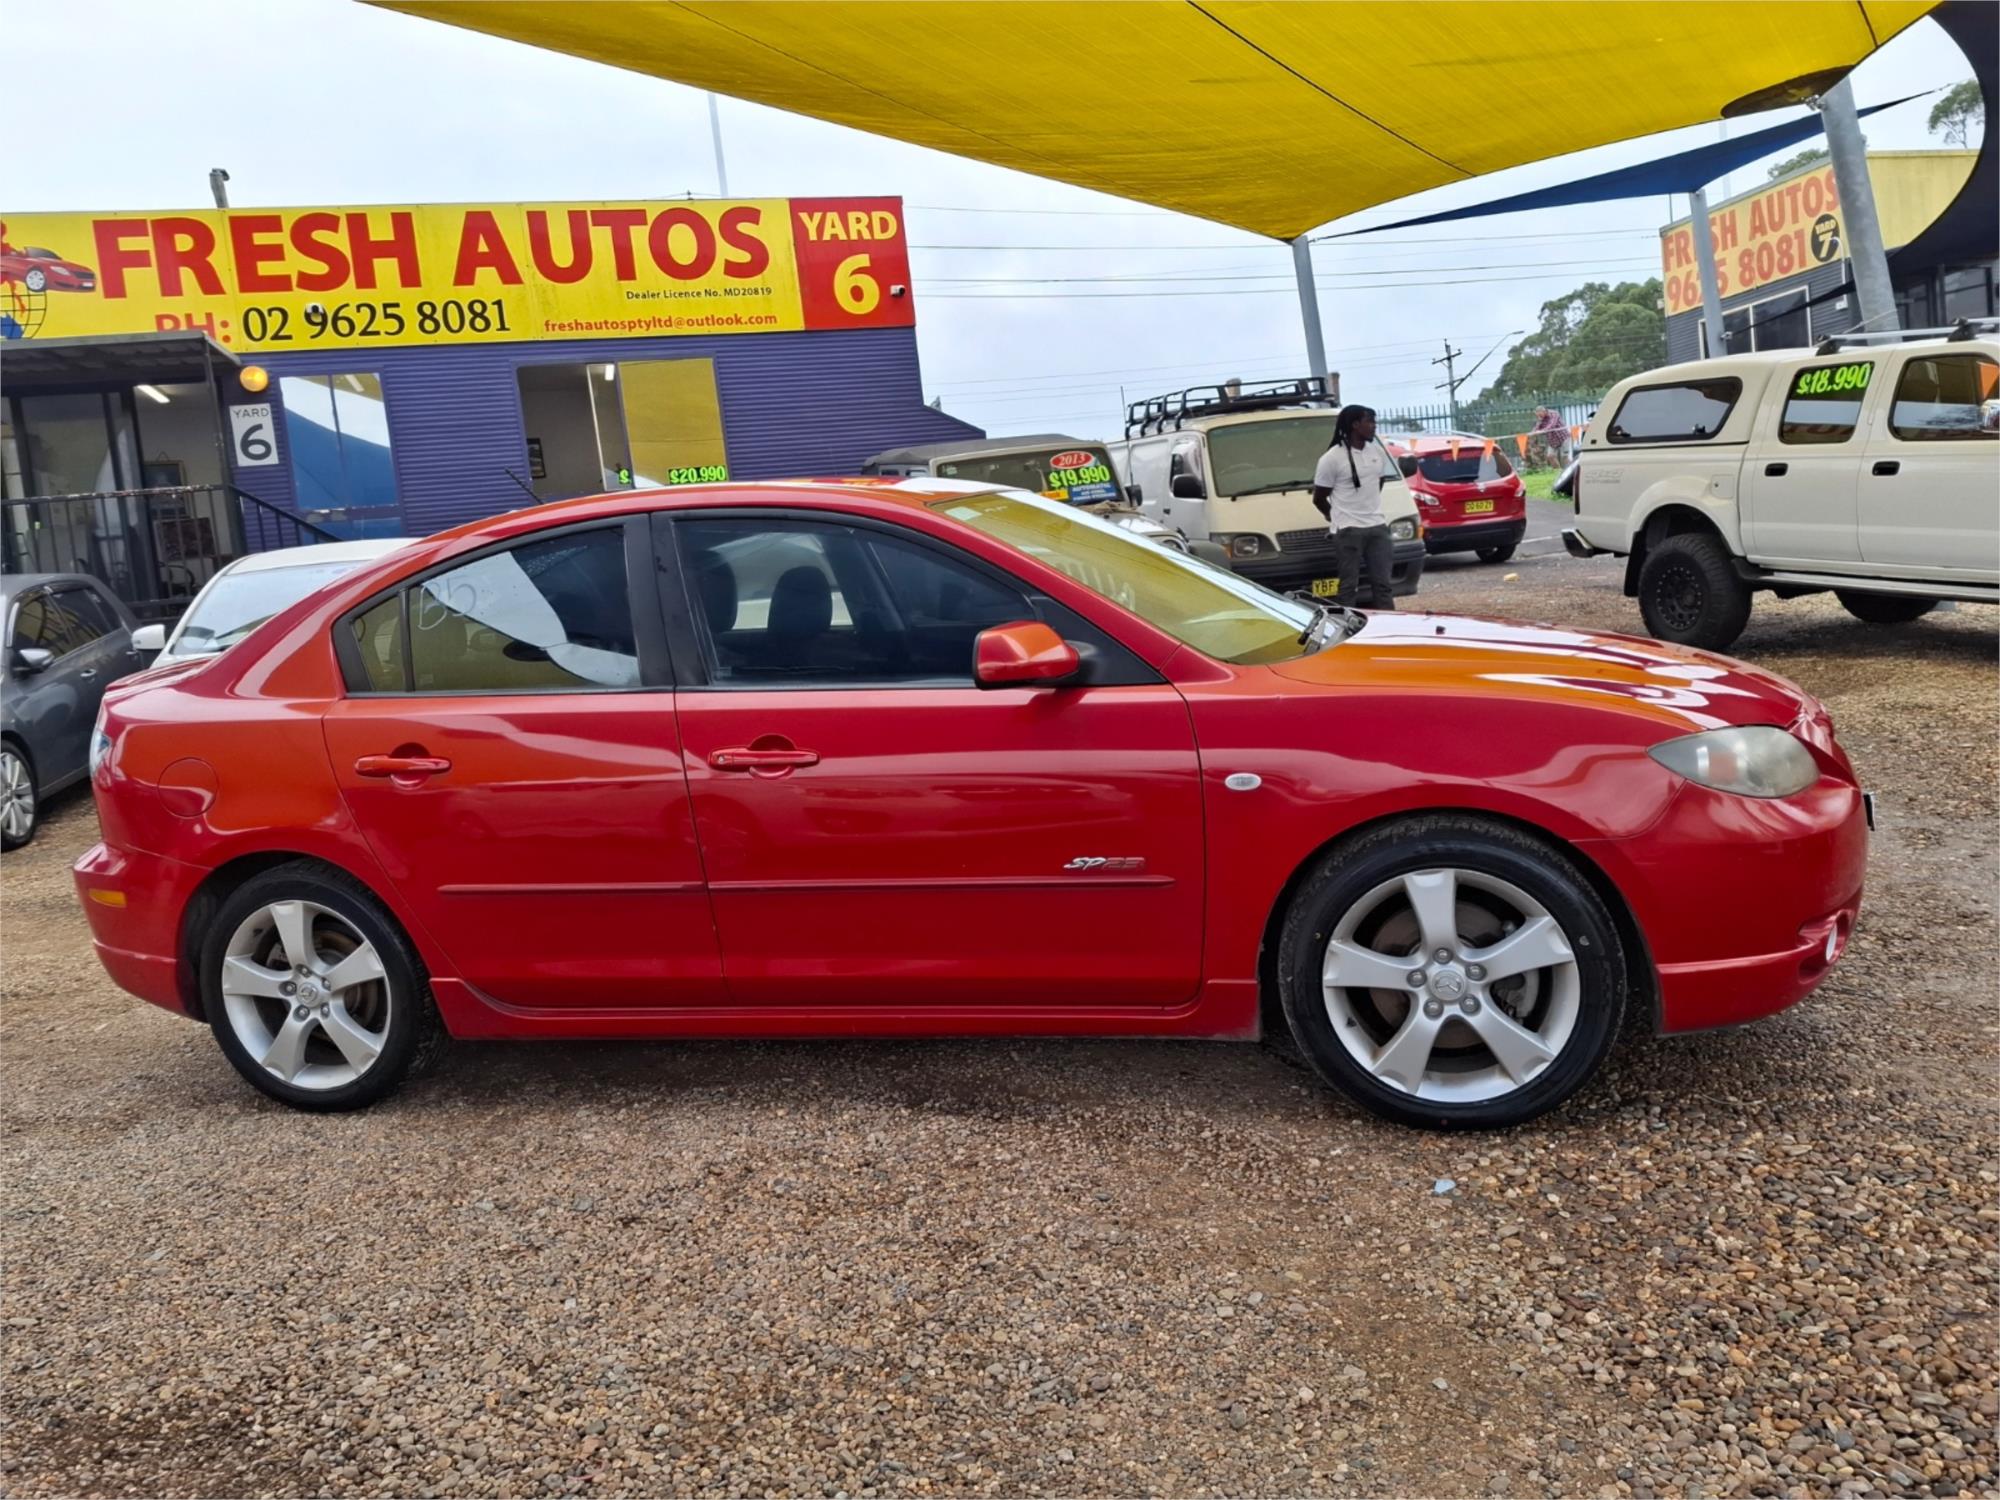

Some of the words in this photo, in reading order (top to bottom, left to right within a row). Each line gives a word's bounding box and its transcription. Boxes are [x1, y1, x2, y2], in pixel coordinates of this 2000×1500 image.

[798, 210, 898, 242] YARD
[1662, 209, 1739, 273] FRSH
[1814, 218, 1837, 236] YARD
[92, 211, 422, 300] FRESH
[453, 206, 771, 288] AUTOS
[1818, 231, 1836, 259] 7
[833, 252, 880, 315] 6
[1666, 258, 1729, 314] 965
[1738, 228, 1808, 288] 8081
[626, 290, 661, 300] Dealer
[663, 289, 702, 299] Licence
[704, 288, 722, 298] No.
[723, 286, 773, 298] MD20819
[242, 306, 293, 342] 02
[303, 303, 406, 340] 9625
[416, 298, 511, 335] 8081
[543, 313, 778, 333] freshautosptyltd@outlook.com
[1796, 362, 1871, 395] $18.990
[233, 407, 269, 419] YARD
[239, 423, 272, 461] 6
[669, 465, 727, 484] $20.990
[1058, 453, 1086, 467] 2013
[1049, 464, 1111, 488] $19.990
